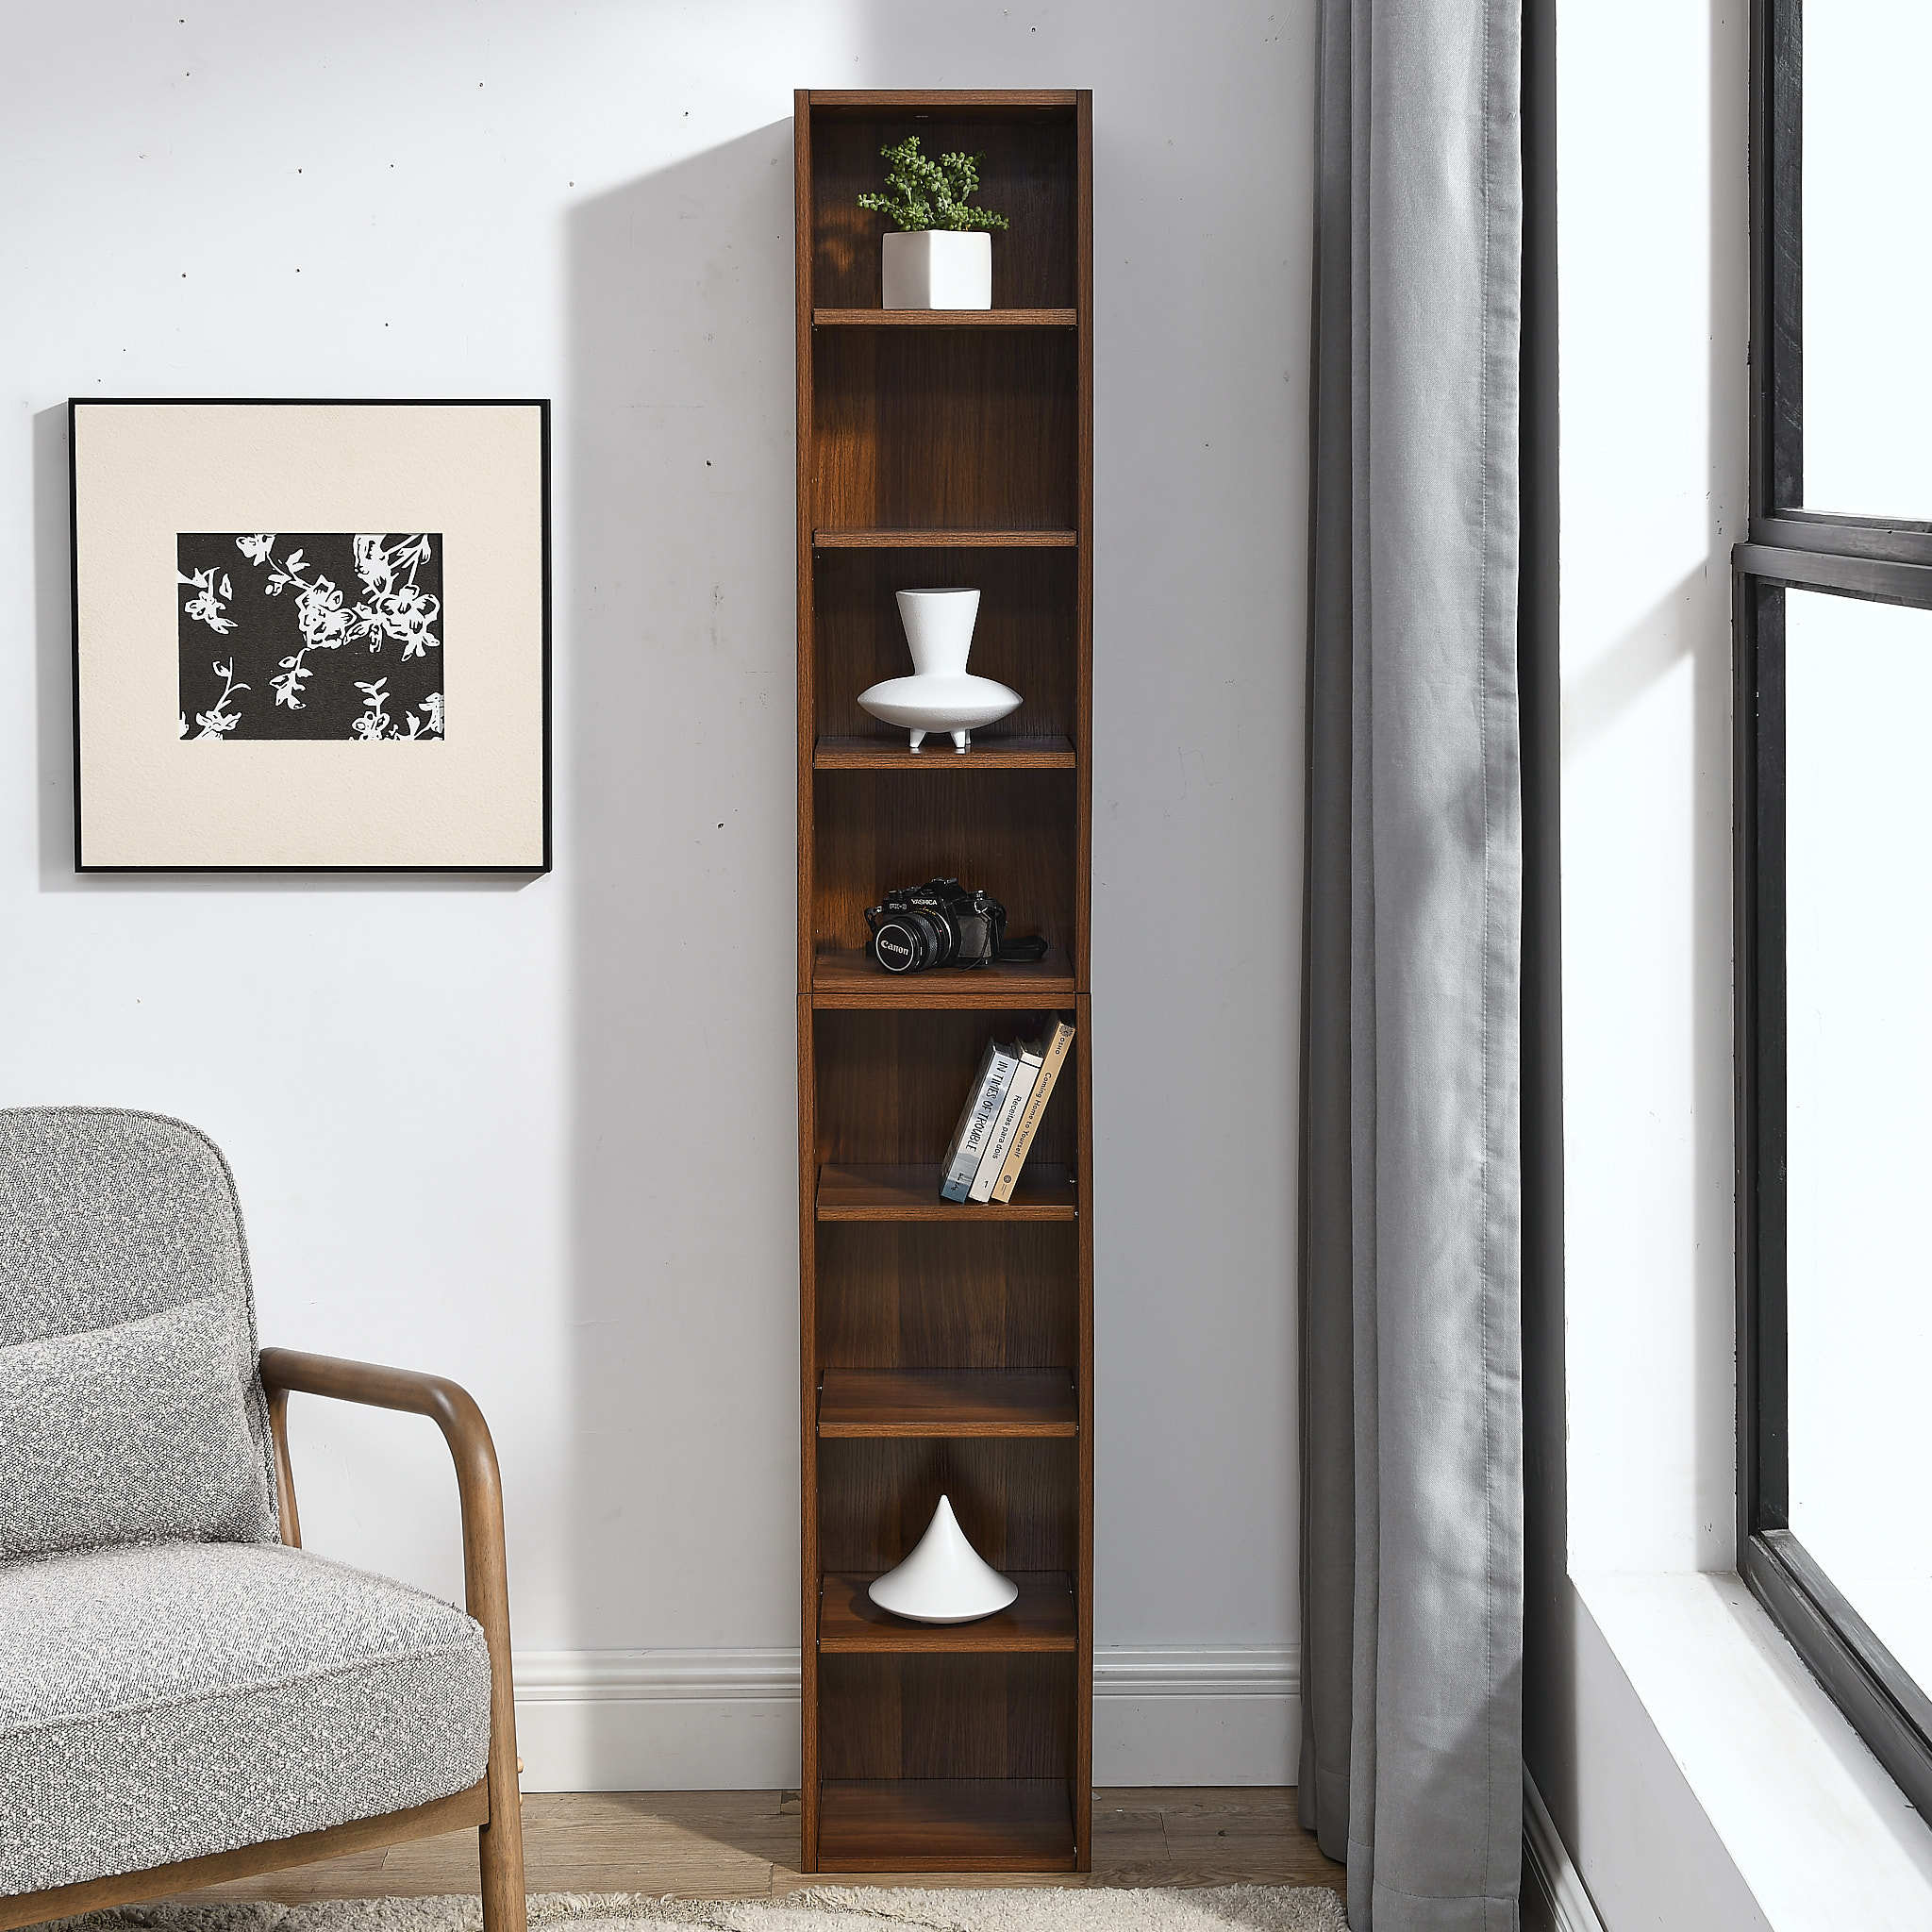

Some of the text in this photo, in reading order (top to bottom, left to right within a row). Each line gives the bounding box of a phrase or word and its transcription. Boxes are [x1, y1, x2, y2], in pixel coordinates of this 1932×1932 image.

[880, 940, 909, 956] Canon
[965, 1060, 1008, 1153] IN TIMES OF TROUBLE
[991, 1094, 1023, 1159] Receitas para dois
[1014, 1072, 1052, 1158] Coming Home to Yourself
